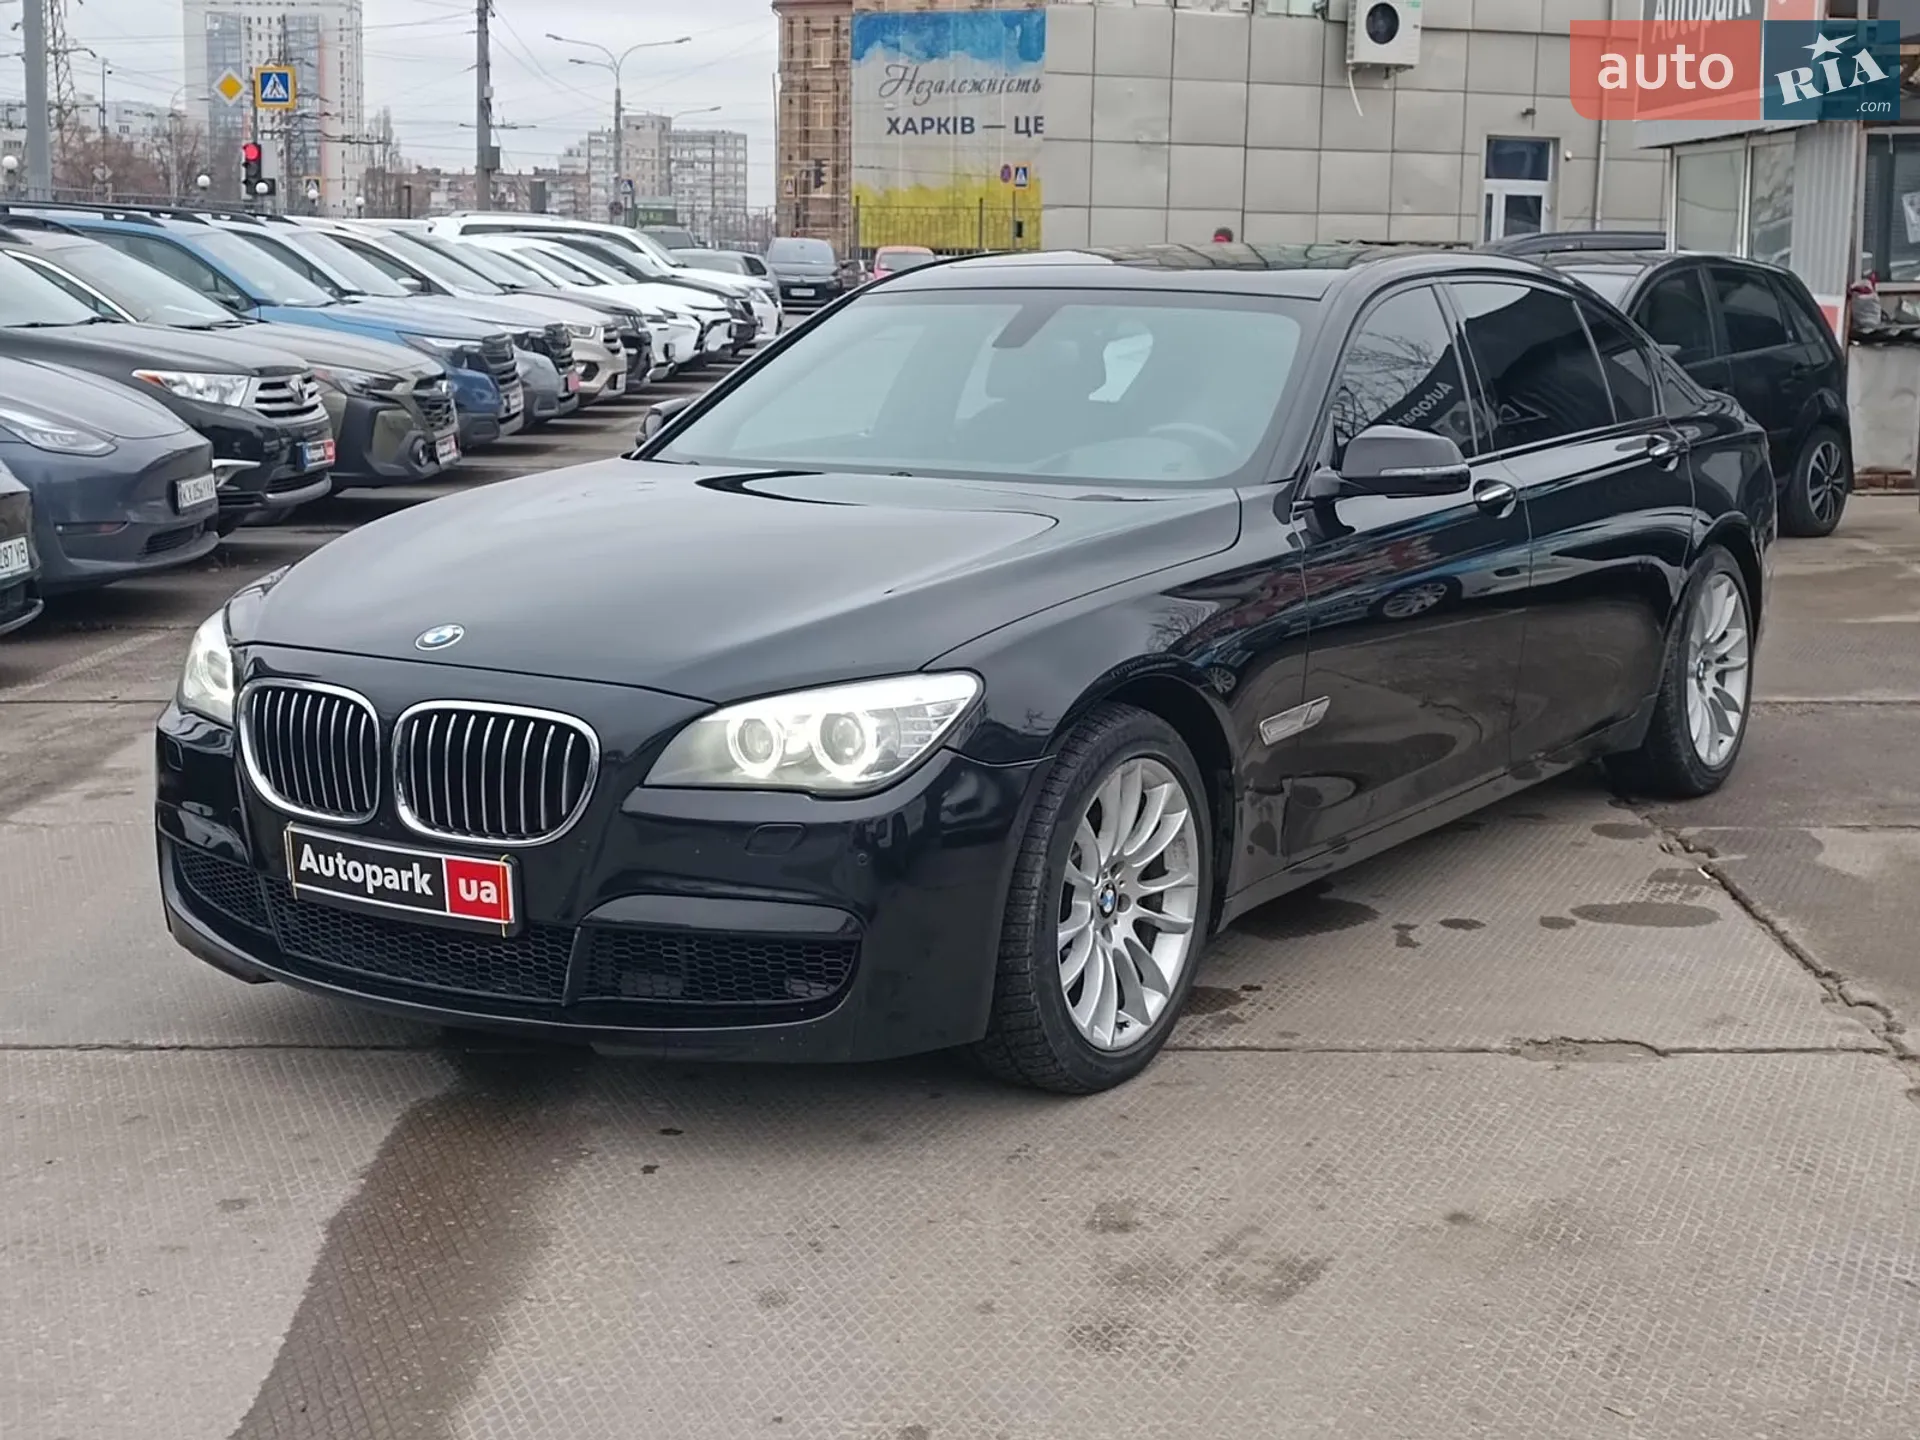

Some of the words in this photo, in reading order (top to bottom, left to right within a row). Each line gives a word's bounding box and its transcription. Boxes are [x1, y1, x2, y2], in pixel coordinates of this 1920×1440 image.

[879, 64, 1042, 106] Незалежність
[886, 116, 975, 135] ХАРКІВ
[1014, 116, 1044, 138] ЦЕ
[299, 843, 433, 896] Autopark
[458, 877, 498, 904] ua
